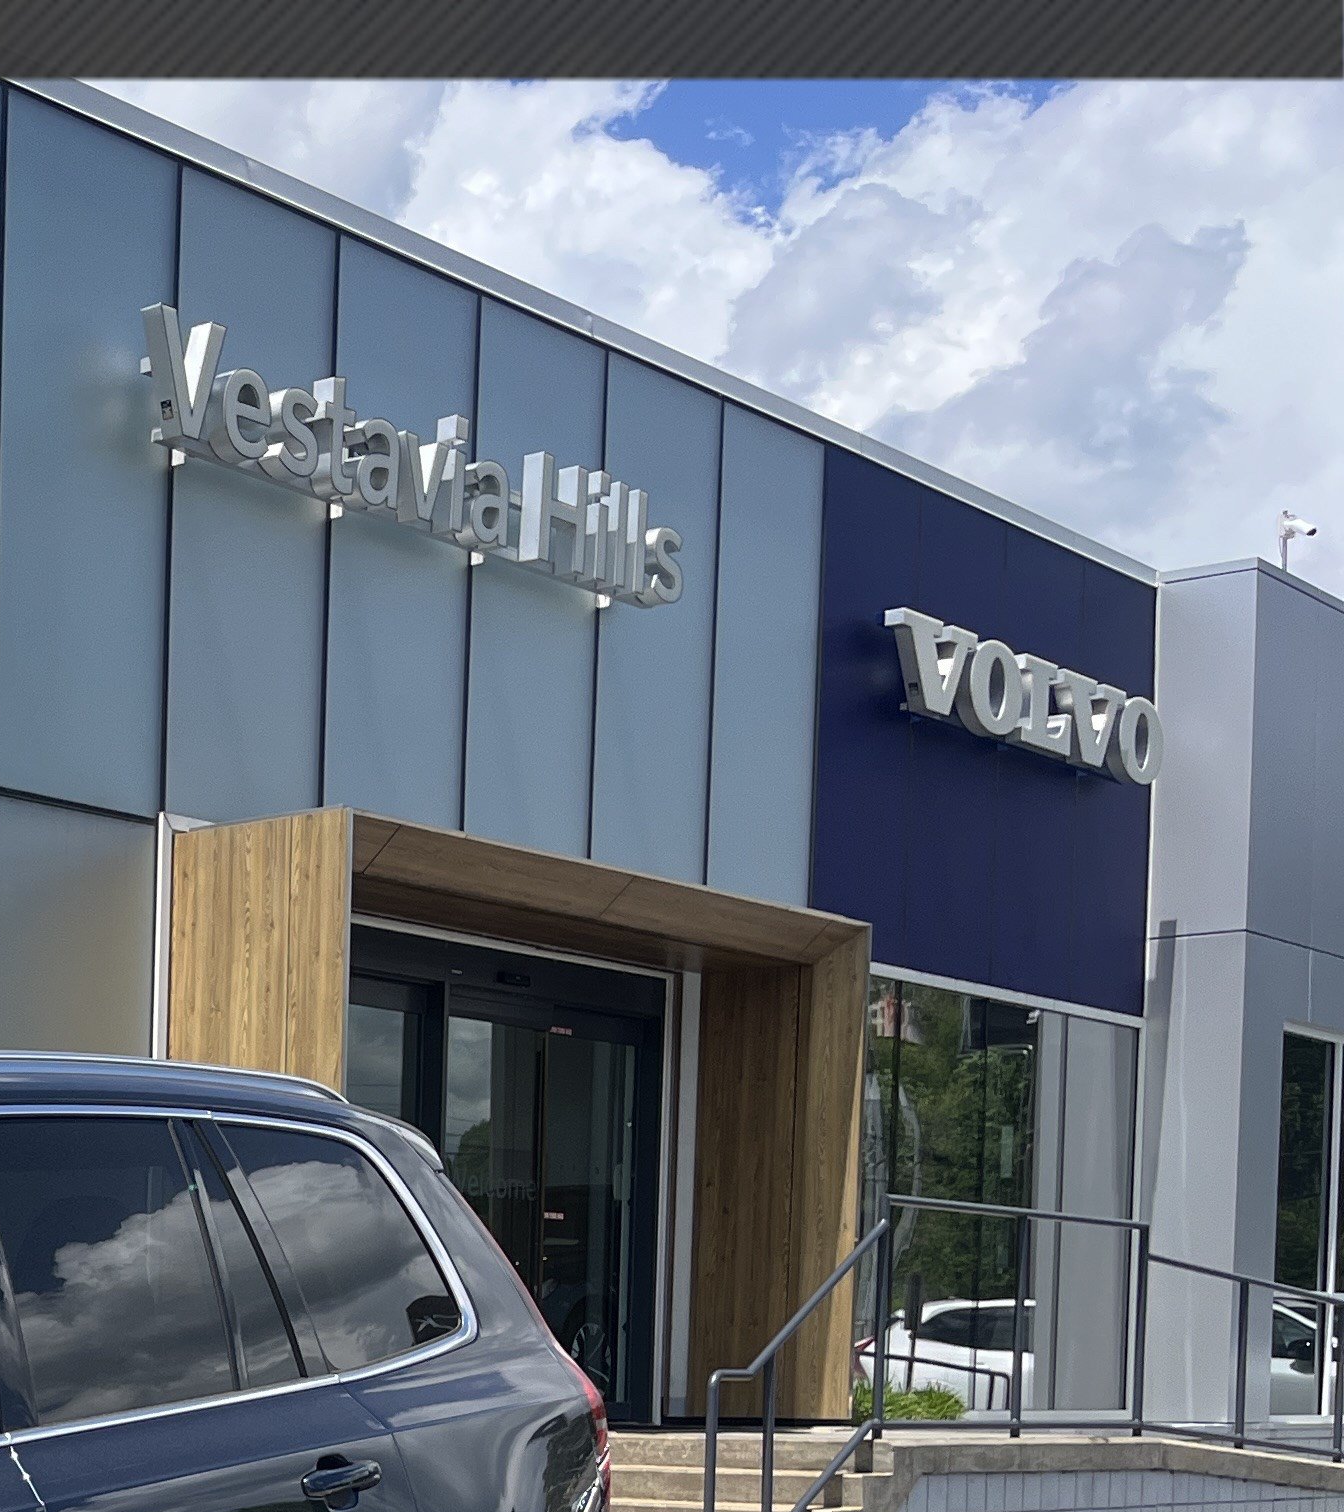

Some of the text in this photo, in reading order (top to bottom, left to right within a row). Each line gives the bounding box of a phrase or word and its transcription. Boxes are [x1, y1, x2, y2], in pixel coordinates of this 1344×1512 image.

[141, 303, 684, 607] Vestavia Hills
[884, 607, 1162, 786] VOLVO
